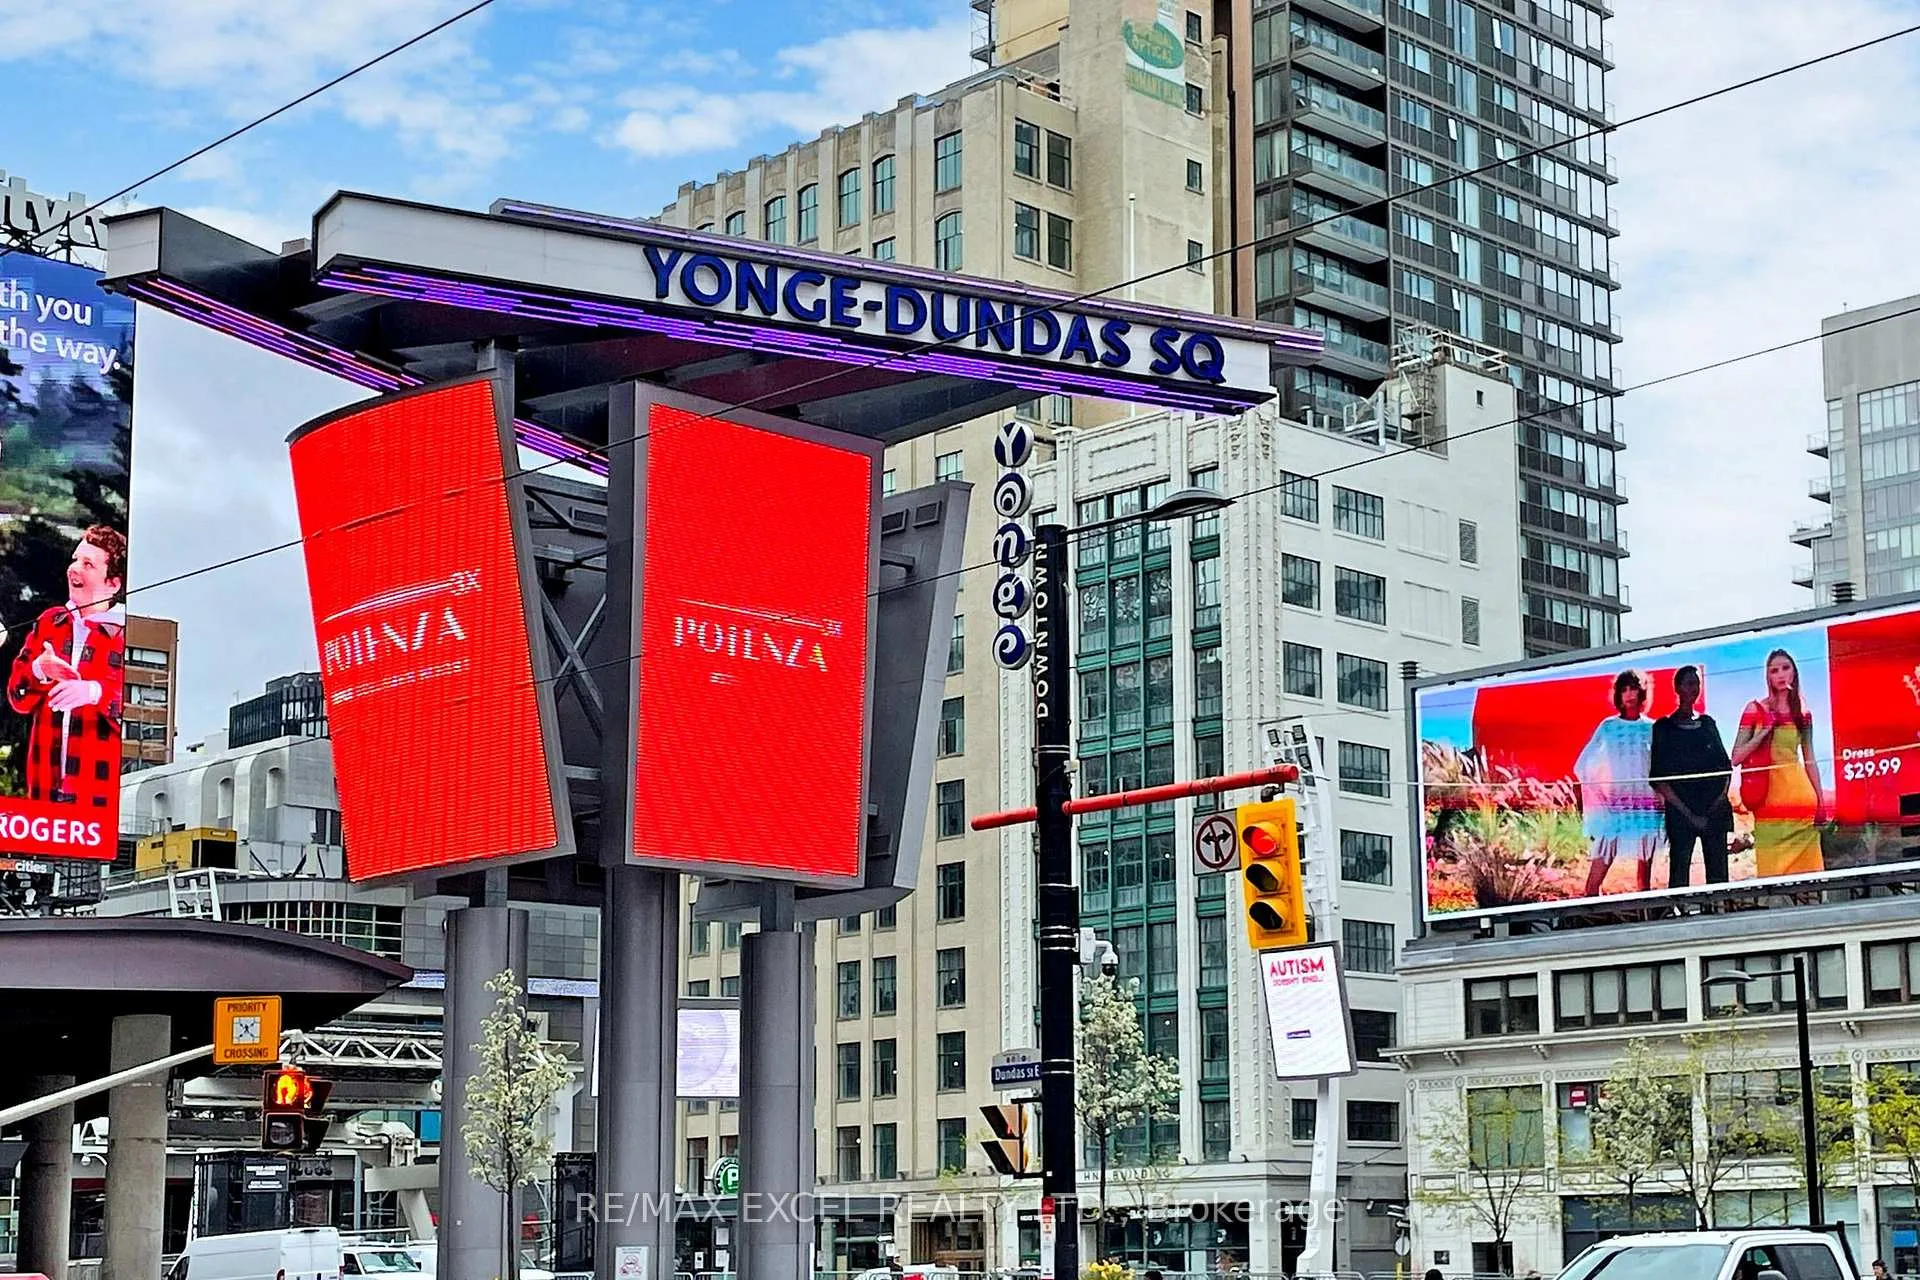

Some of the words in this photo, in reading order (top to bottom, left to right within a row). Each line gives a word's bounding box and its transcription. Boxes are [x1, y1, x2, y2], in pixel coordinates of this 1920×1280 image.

[34, 294, 92, 326] you
[643, 247, 1131, 368] YONGE-DUNDAS
[1151, 326, 1226, 384] SQ
[55, 337, 121, 375] way.
[1035, 543, 1049, 719] DOWNTOWN
[1843, 748, 1875, 760] Dress
[1844, 757, 1901, 781] $29.99
[15, 861, 48, 873] cities
[1270, 956, 1325, 977] AUTISM
[227, 1002, 267, 1013] PRIORITY
[224, 1047, 269, 1059] CROSSING
[995, 1067, 1025, 1080] Dundas
[1034, 1064, 1040, 1077] E
